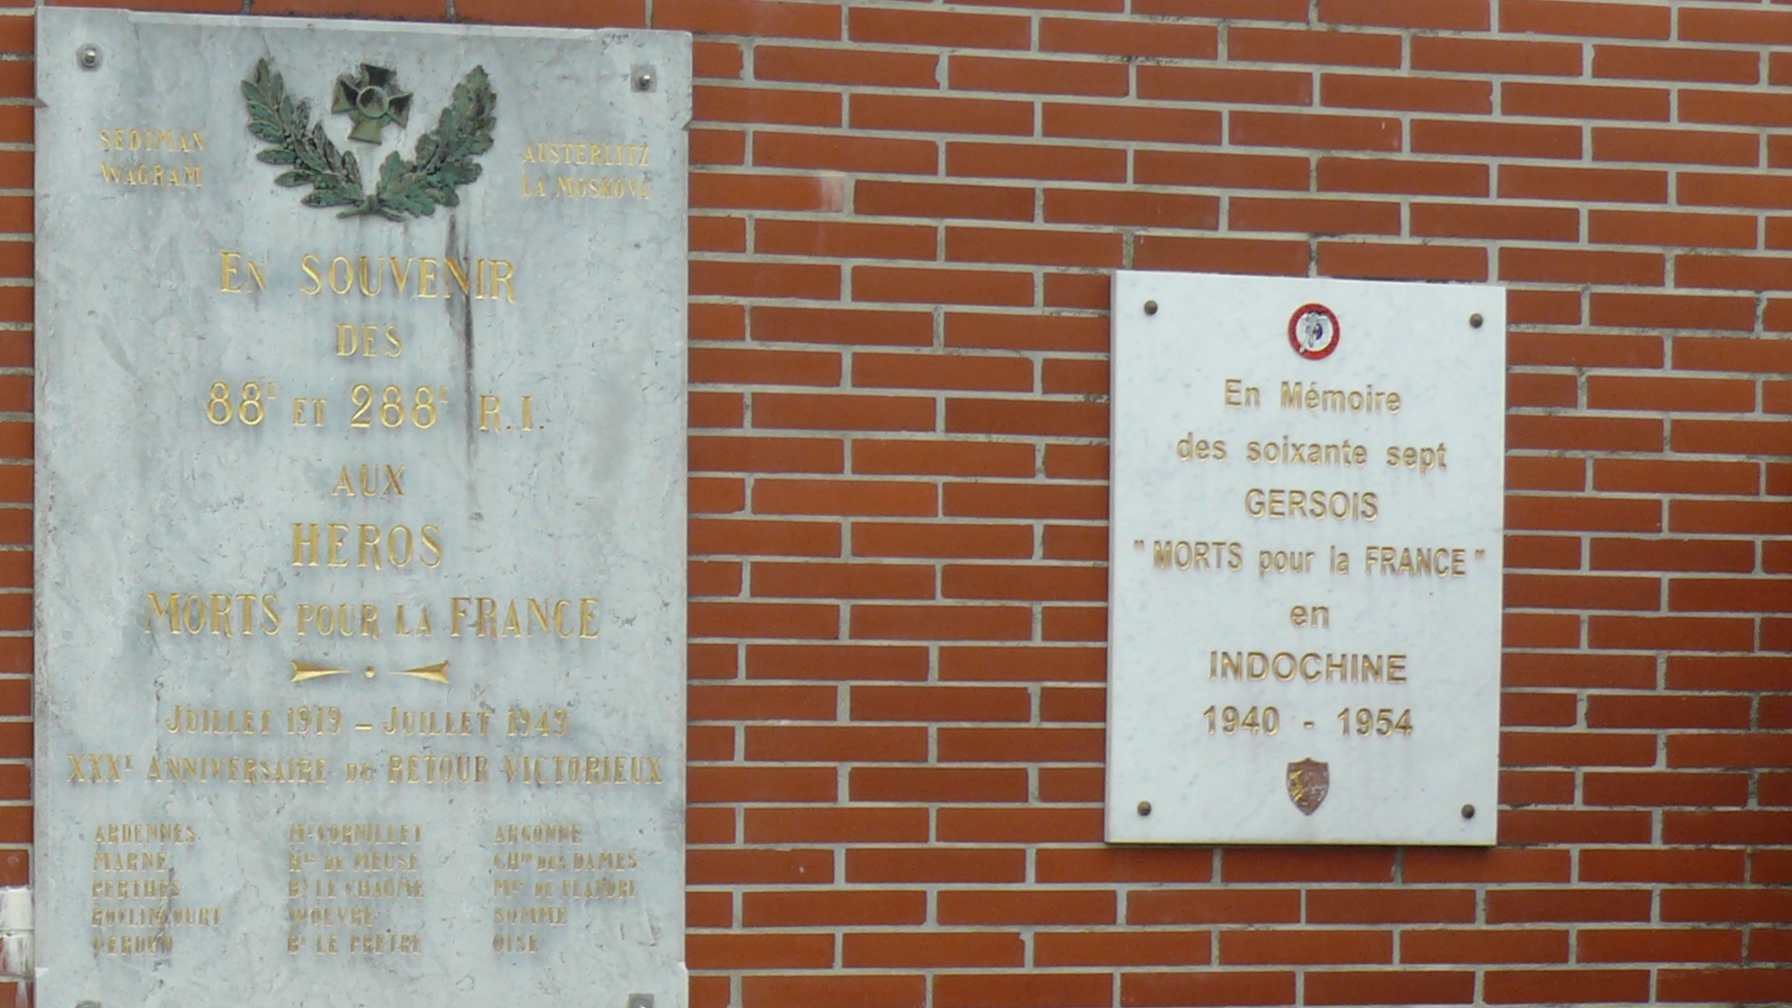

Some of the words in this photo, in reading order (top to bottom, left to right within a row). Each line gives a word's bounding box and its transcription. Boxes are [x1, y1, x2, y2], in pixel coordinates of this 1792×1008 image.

[99, 128, 206, 153] SEDIMAN
[521, 142, 650, 167] AUSTERLITZ
[100, 162, 203, 187] WAGRAM
[521, 174, 546, 197] LA
[556, 176, 651, 200] MOSKOVA
[300, 253, 518, 304] SOUVENIR
[337, 323, 405, 358] DES
[1224, 379, 1260, 409] En
[1280, 380, 1402, 414] Mémoire
[293, 397, 328, 428] ET
[479, 394, 546, 433] R.I.
[1176, 433, 1227, 461] des
[1246, 435, 1368, 469] soixante
[1386, 440, 1448, 477] sept
[332, 463, 406, 498] AUX
[1244, 487, 1379, 523] GERSOIS
[290, 522, 444, 569] HEROS
[1153, 540, 1243, 572] MORTS
[1259, 548, 1316, 578] pour
[1329, 545, 1350, 576] la
[1365, 546, 1467, 578] FRANCE
[144, 591, 282, 638] MORTS
[296, 602, 380, 640] POUR
[396, 604, 434, 636] LA
[450, 596, 601, 640] FRANCE
[1289, 604, 1330, 629] en
[1209, 650, 1408, 684] INDOCHINE
[287, 705, 344, 736] 1919
[507, 707, 569, 738] 1949
[1202, 705, 1280, 736] 1940
[1336, 707, 1414, 738] 1954
[387, 755, 490, 785] RETOUR
[503, 755, 663, 786] VICTORIEUX
[93, 823, 198, 845] ARDENNES
[316, 823, 424, 846] CORNILLET
[492, 824, 583, 846] ARGONNE
[92, 851, 169, 873] MARNE
[324, 855, 345, 873] DE
[353, 852, 420, 873] MEUSE
[537, 855, 568, 873] DES
[573, 852, 638, 873] DAMES
[92, 879, 182, 899] PERTHES
[315, 879, 338, 899] LE
[344, 879, 425, 900] CHAUME
[534, 882, 554, 899] DE
[561, 879, 639, 900] FLANDRE
[91, 907, 221, 928] ROCLINCOURT
[288, 906, 374, 928] WOEVRE
[492, 906, 568, 927] SOMME
[92, 935, 174, 956] VERDUN
[315, 934, 339, 956] LE
[491, 933, 540, 954] OISE
